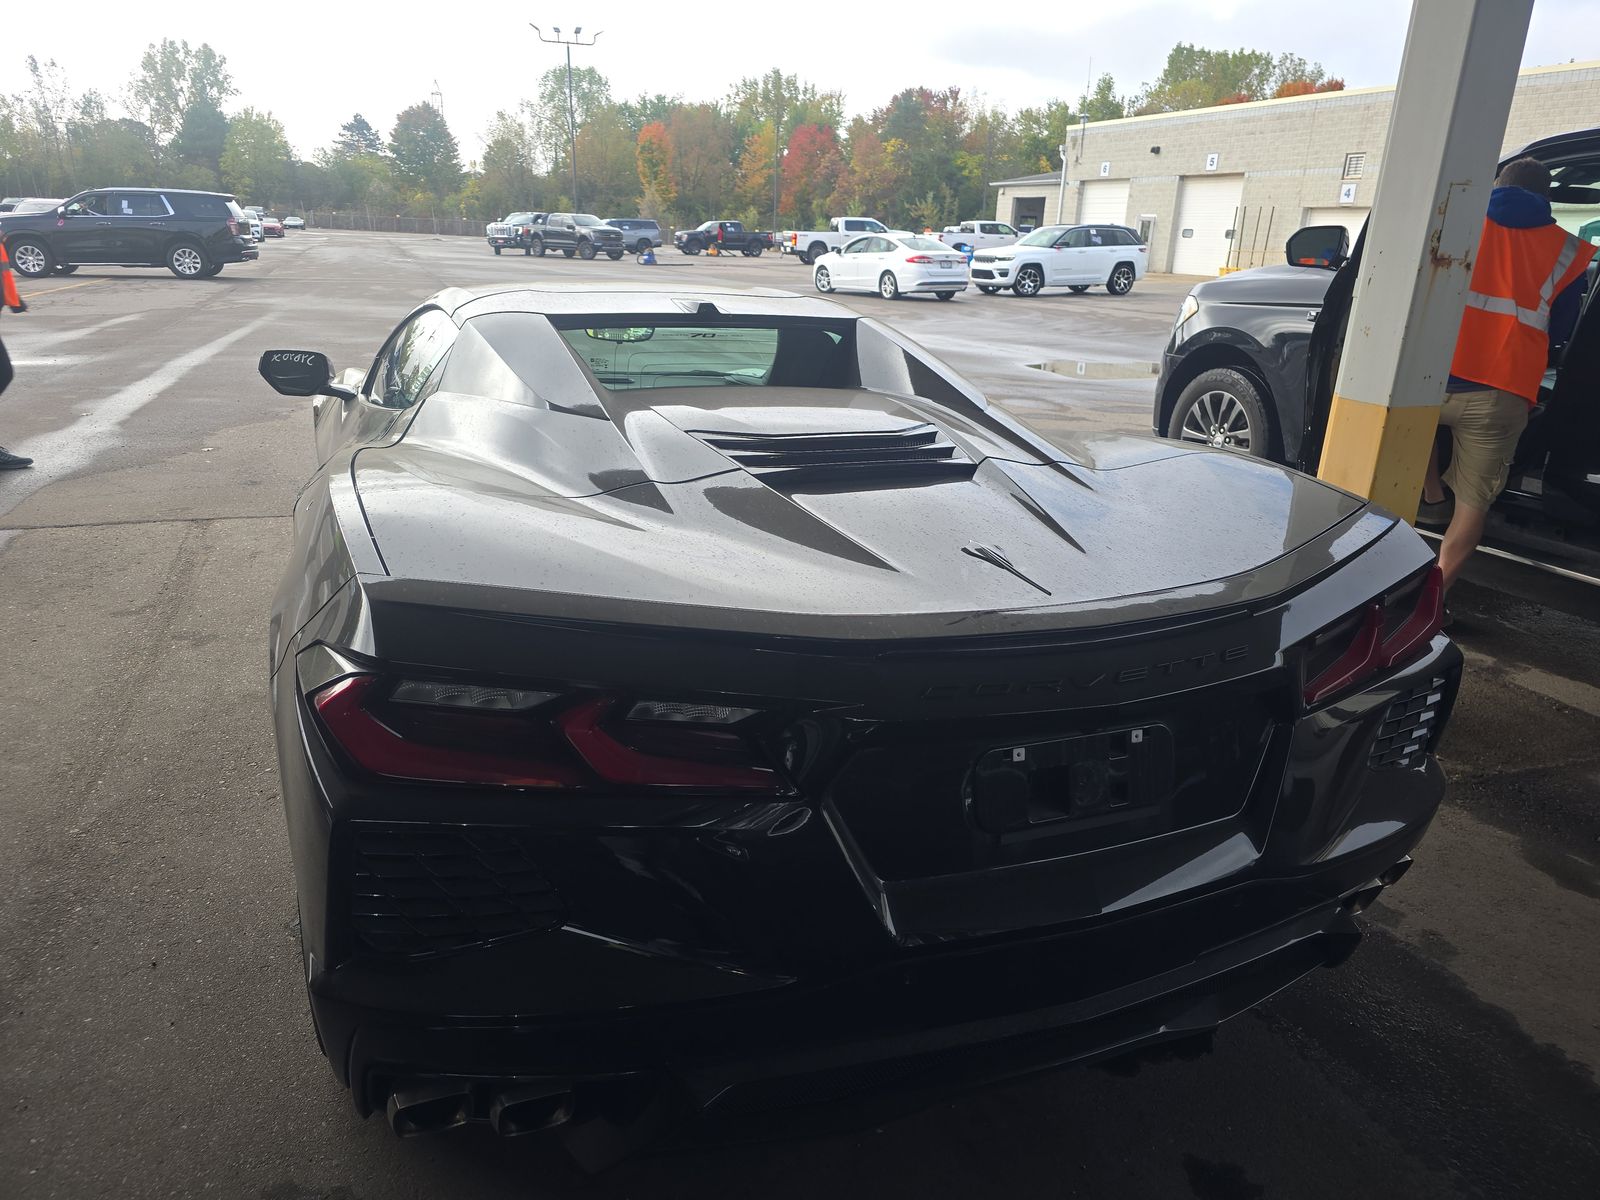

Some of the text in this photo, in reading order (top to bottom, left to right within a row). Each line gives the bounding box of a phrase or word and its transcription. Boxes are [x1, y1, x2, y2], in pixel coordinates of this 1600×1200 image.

[1209, 157, 1215, 167] 5
[1102, 164, 1108, 174] 6
[1344, 187, 1351, 199] 4
[920, 644, 1250, 701] CORVETTE
